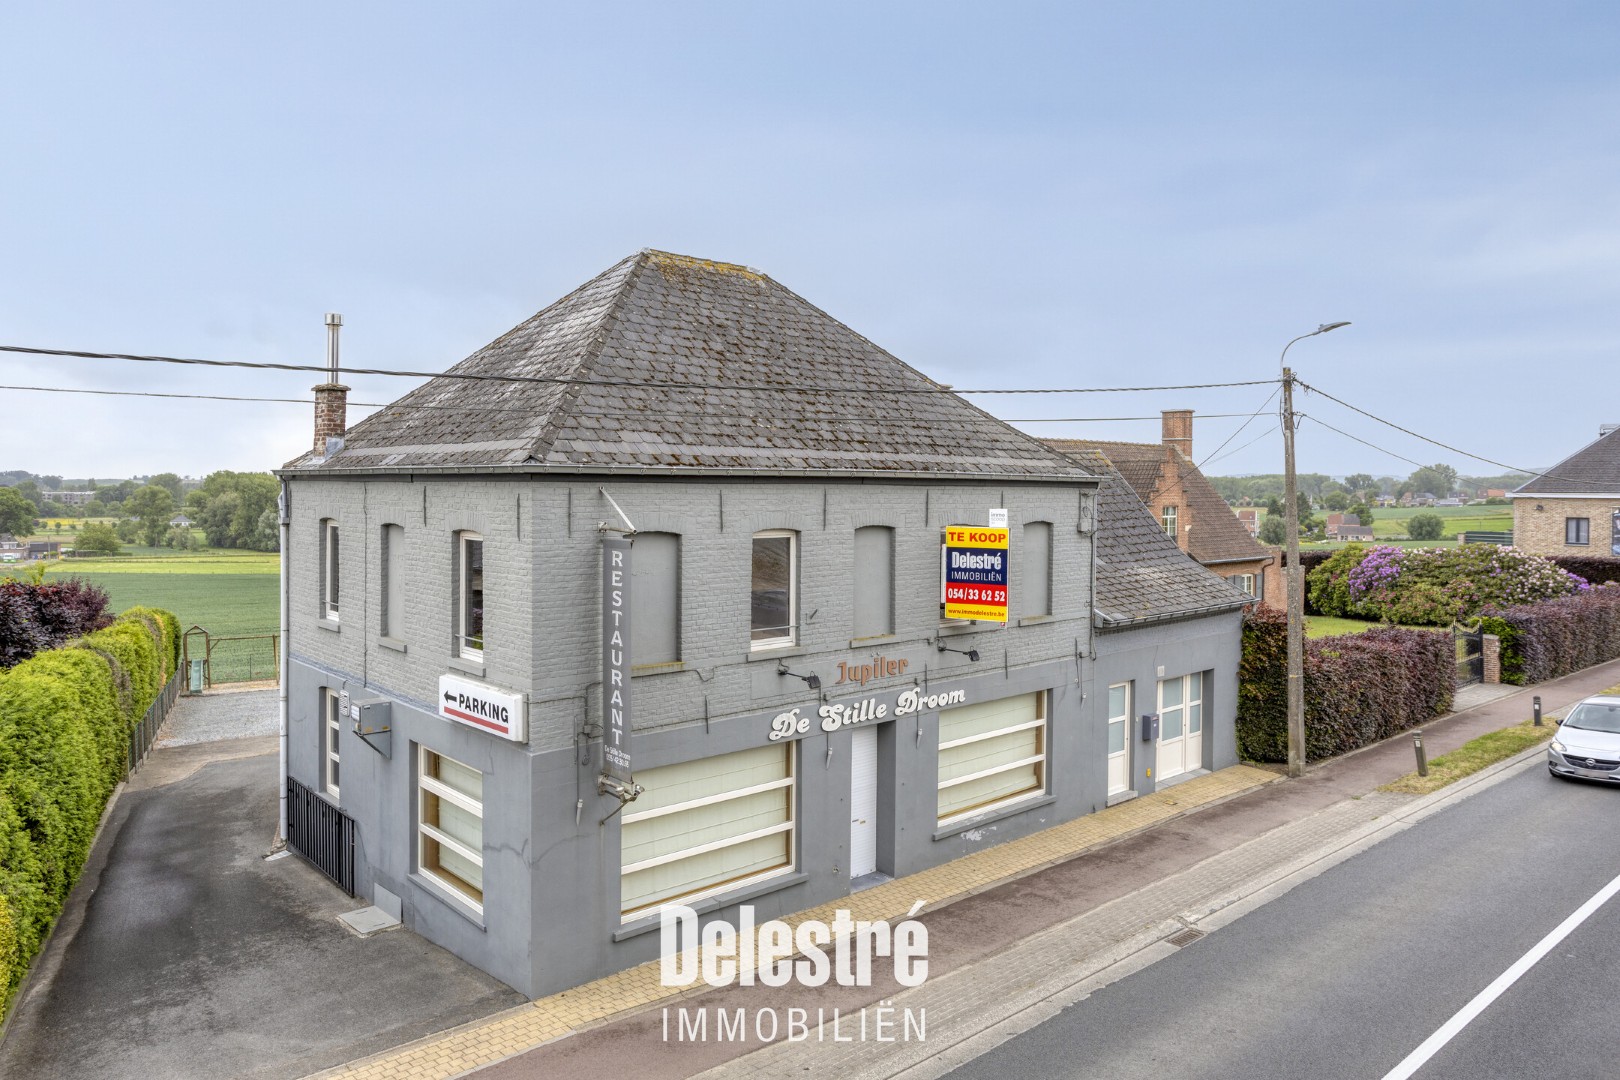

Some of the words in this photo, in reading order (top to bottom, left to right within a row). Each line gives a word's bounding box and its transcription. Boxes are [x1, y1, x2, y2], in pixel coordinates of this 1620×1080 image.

[948, 532, 965, 542] TE
[969, 533, 1006, 543] KOOP
[952, 552, 1001, 570] Delestré
[952, 571, 1002, 582] IMMOBILIËN
[948, 588, 979, 600] 054/33
[981, 590, 992, 601] 62
[994, 591, 1005, 602] 52
[948, 608, 1005, 617] www.immodelestre.be
[610, 550, 623, 745] RESTAURANT
[835, 656, 909, 686] Jupiler
[459, 693, 509, 723] PARKING
[768, 708, 810, 741] De
[818, 698, 887, 732] Stille
[894, 687, 966, 716] Droom
